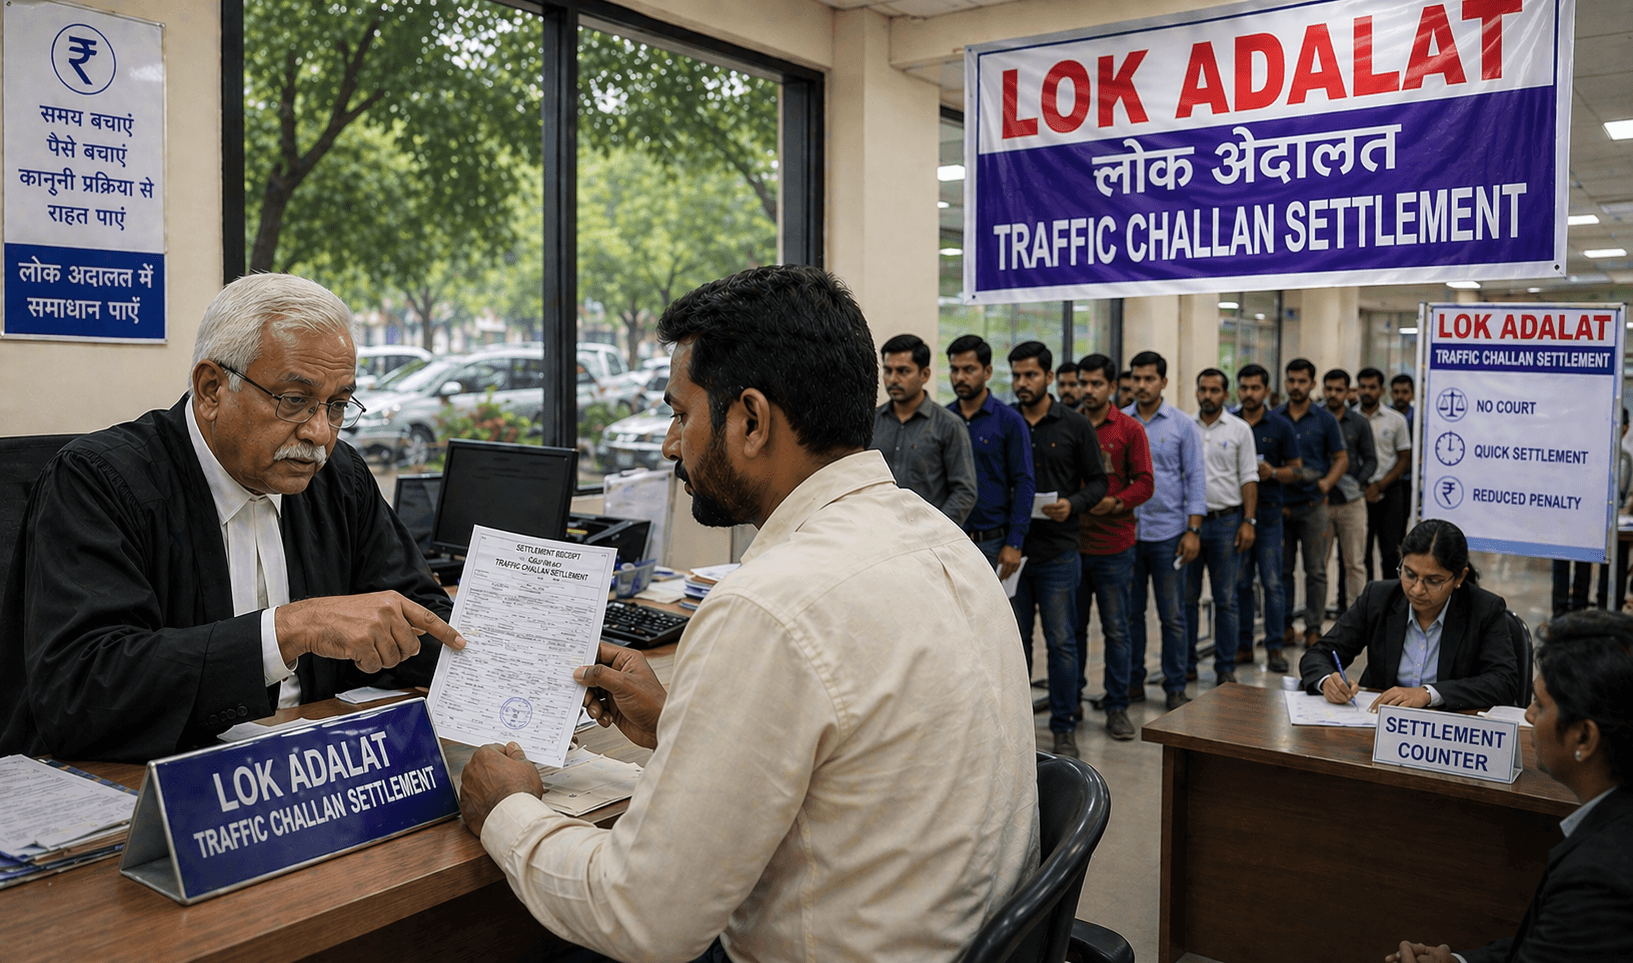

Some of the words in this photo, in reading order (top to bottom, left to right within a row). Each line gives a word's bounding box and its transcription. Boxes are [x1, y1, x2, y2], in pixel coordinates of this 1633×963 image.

[1001, 48, 1150, 140] LOK
[1174, 0, 1523, 119] ADALAT
[38, 104, 84, 128] समय
[89, 112, 135, 138] बचाएं
[45, 131, 78, 159] पैसे
[82, 143, 128, 168] बचाएं
[1091, 138, 1195, 198] लोक
[81, 170, 135, 197] प्रक्रिया
[138, 176, 155, 199] से
[47, 204, 90, 226] राहत
[94, 206, 127, 232] पाएं
[993, 215, 1117, 271] TRAFFIC
[1126, 203, 1275, 263] CHALLAN
[1284, 182, 1527, 253] SETTLEMENT
[17, 255, 62, 284] लोक
[137, 262, 155, 289] में
[26, 297, 102, 320] समाधान
[1438, 313, 1493, 340] LOK
[1499, 313, 1612, 341] ADALAT
[1436, 349, 1479, 365] TRAFFIC
[1481, 350, 1534, 367] CHALLAN
[1537, 351, 1610, 368] SETTLEMENT
[1476, 399, 1494, 414] NO
[1496, 400, 1537, 415] COURT
[1474, 444, 1510, 460] QUICK
[1512, 446, 1589, 465] SETTLEMENT
[1472, 488, 1527, 506] REDUCED
[1529, 493, 1582, 510] PENALTY
[495, 557, 522, 570] TRAFFIC
[1386, 716, 1506, 748] SETTLEMENT
[212, 757, 285, 813] LOK
[288, 731, 391, 793] ADALAT
[1398, 741, 1488, 772] COUNTER
[193, 815, 268, 859] TRAFFIC
[269, 792, 347, 837] CHALLAN
[348, 766, 437, 813] SETTLEMENT
